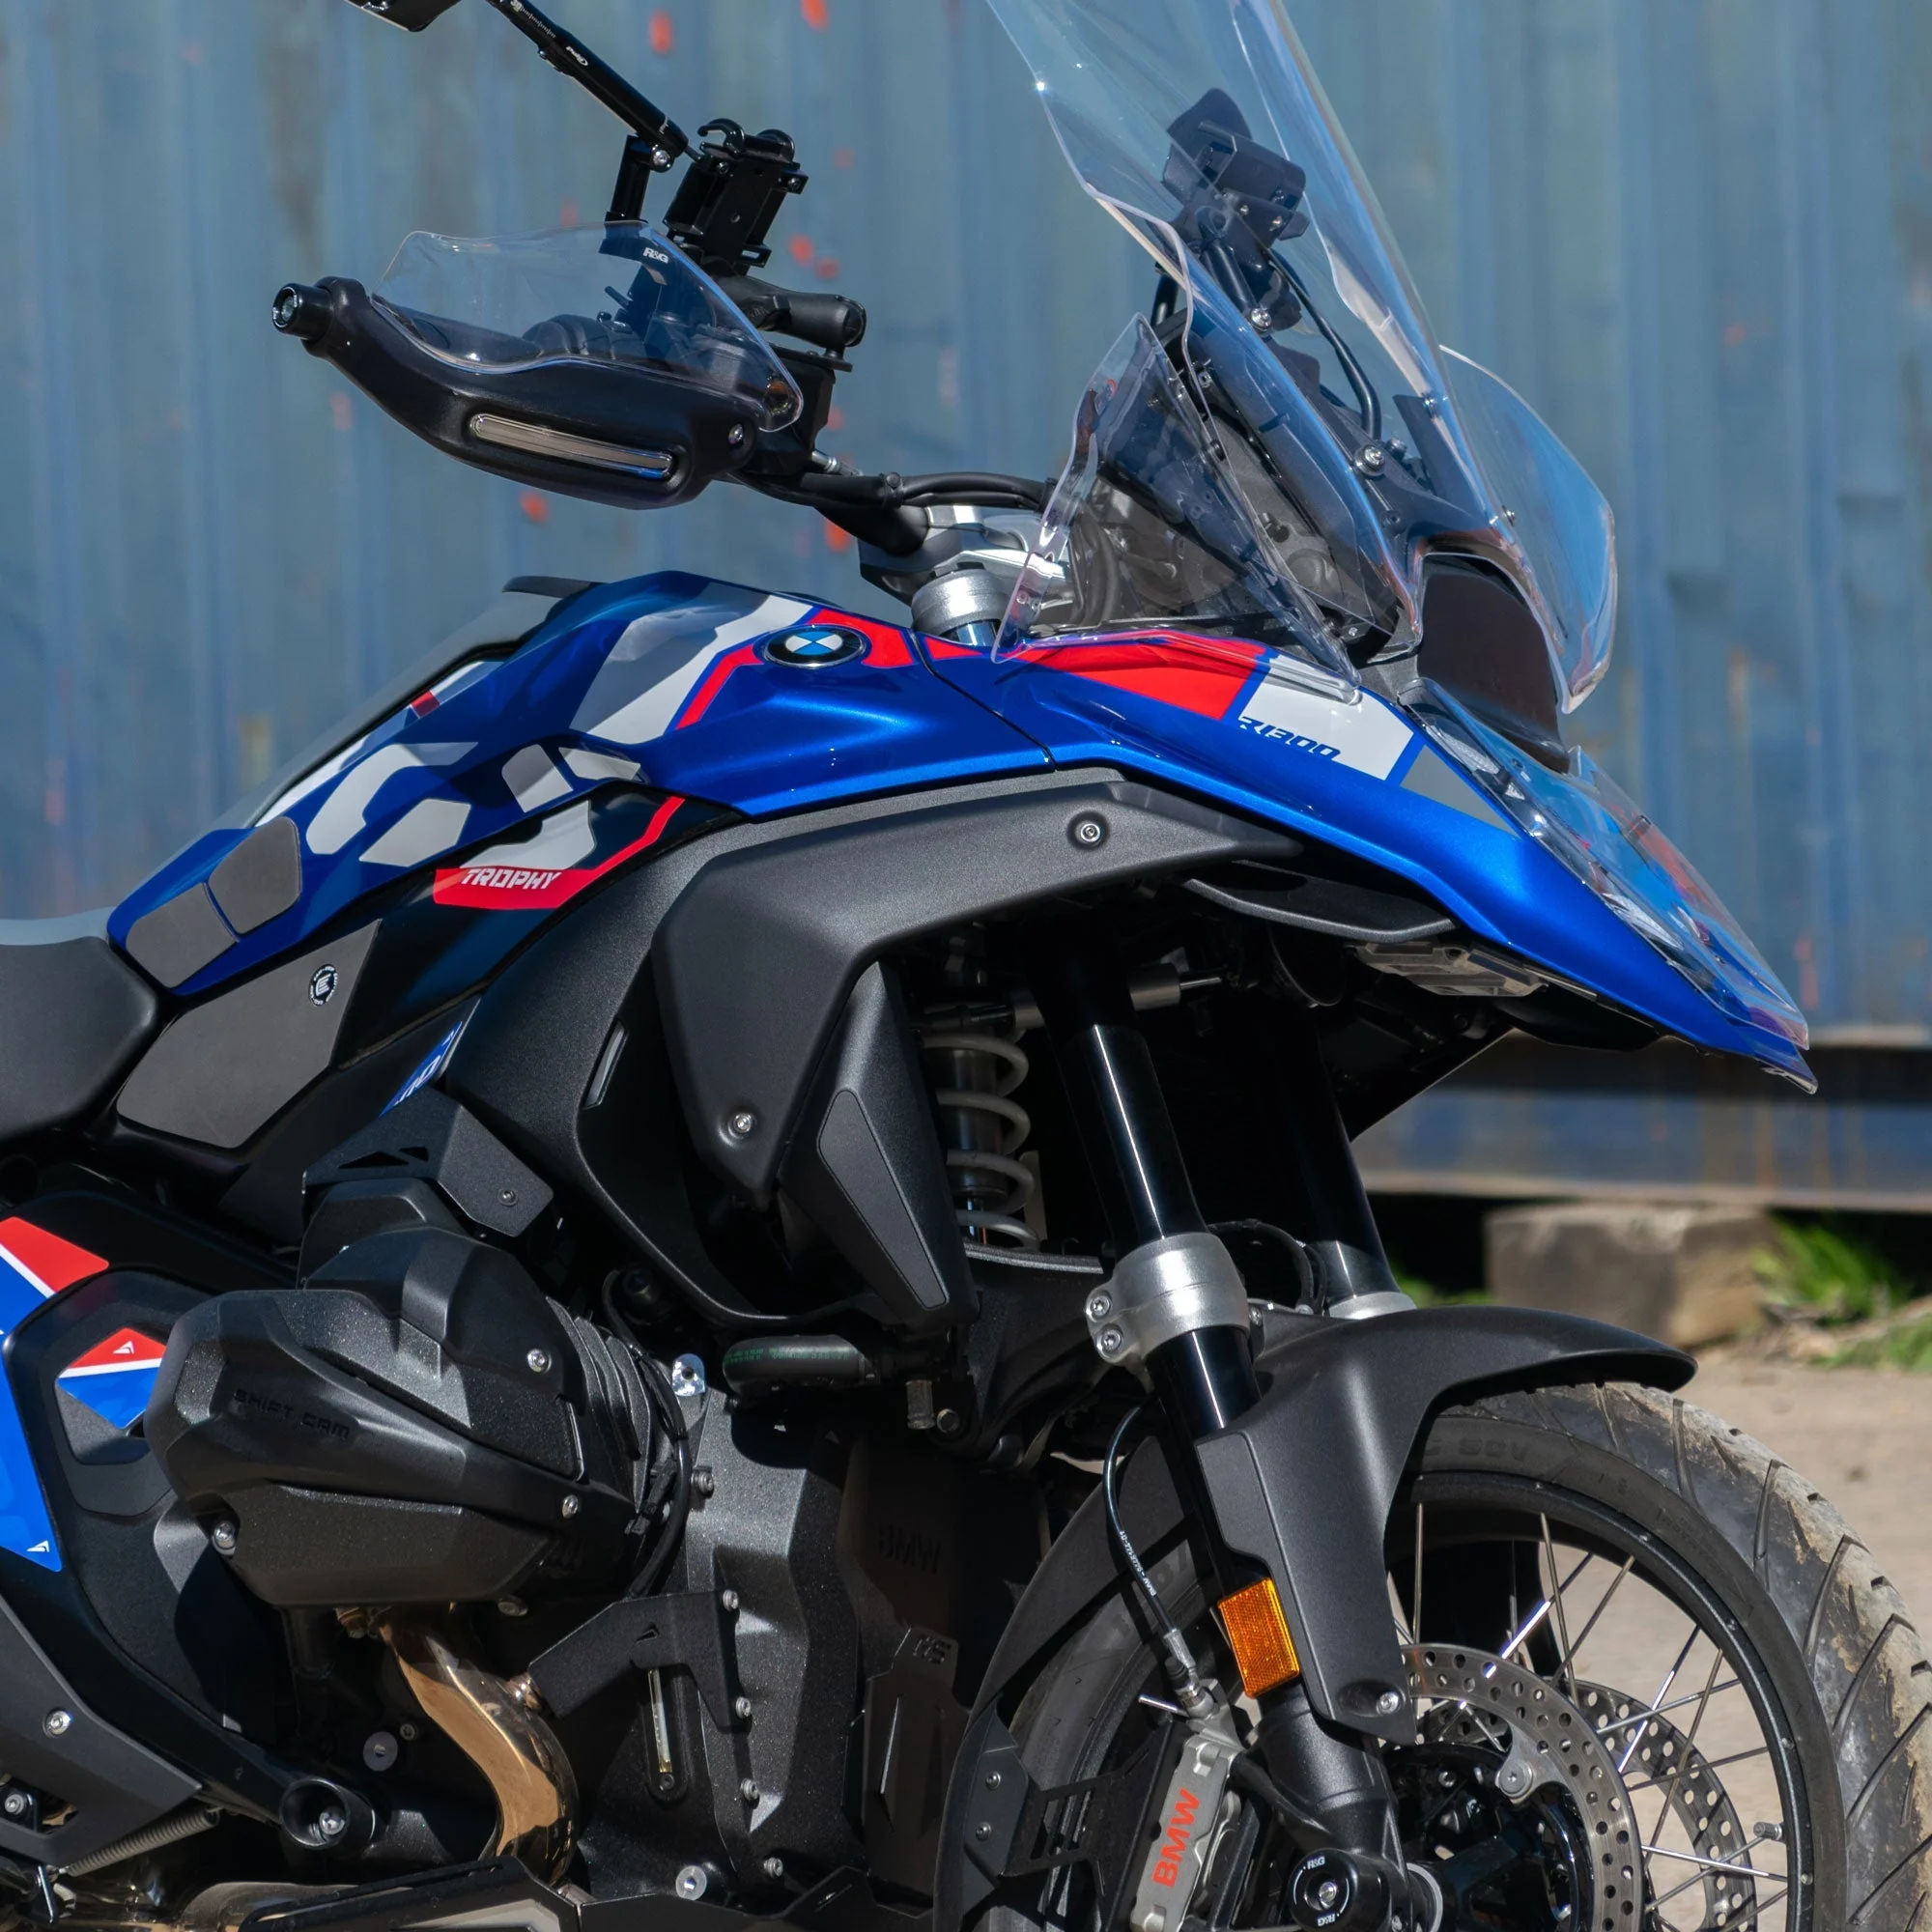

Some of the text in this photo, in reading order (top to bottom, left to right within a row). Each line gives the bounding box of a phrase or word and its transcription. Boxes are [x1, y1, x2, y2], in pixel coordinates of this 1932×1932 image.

[642, 246, 669, 264] R&G
[461, 867, 562, 890] TROPHY
[234, 1388, 351, 1440] SHIFT CAM
[1151, 1786, 1200, 1889] BMW
